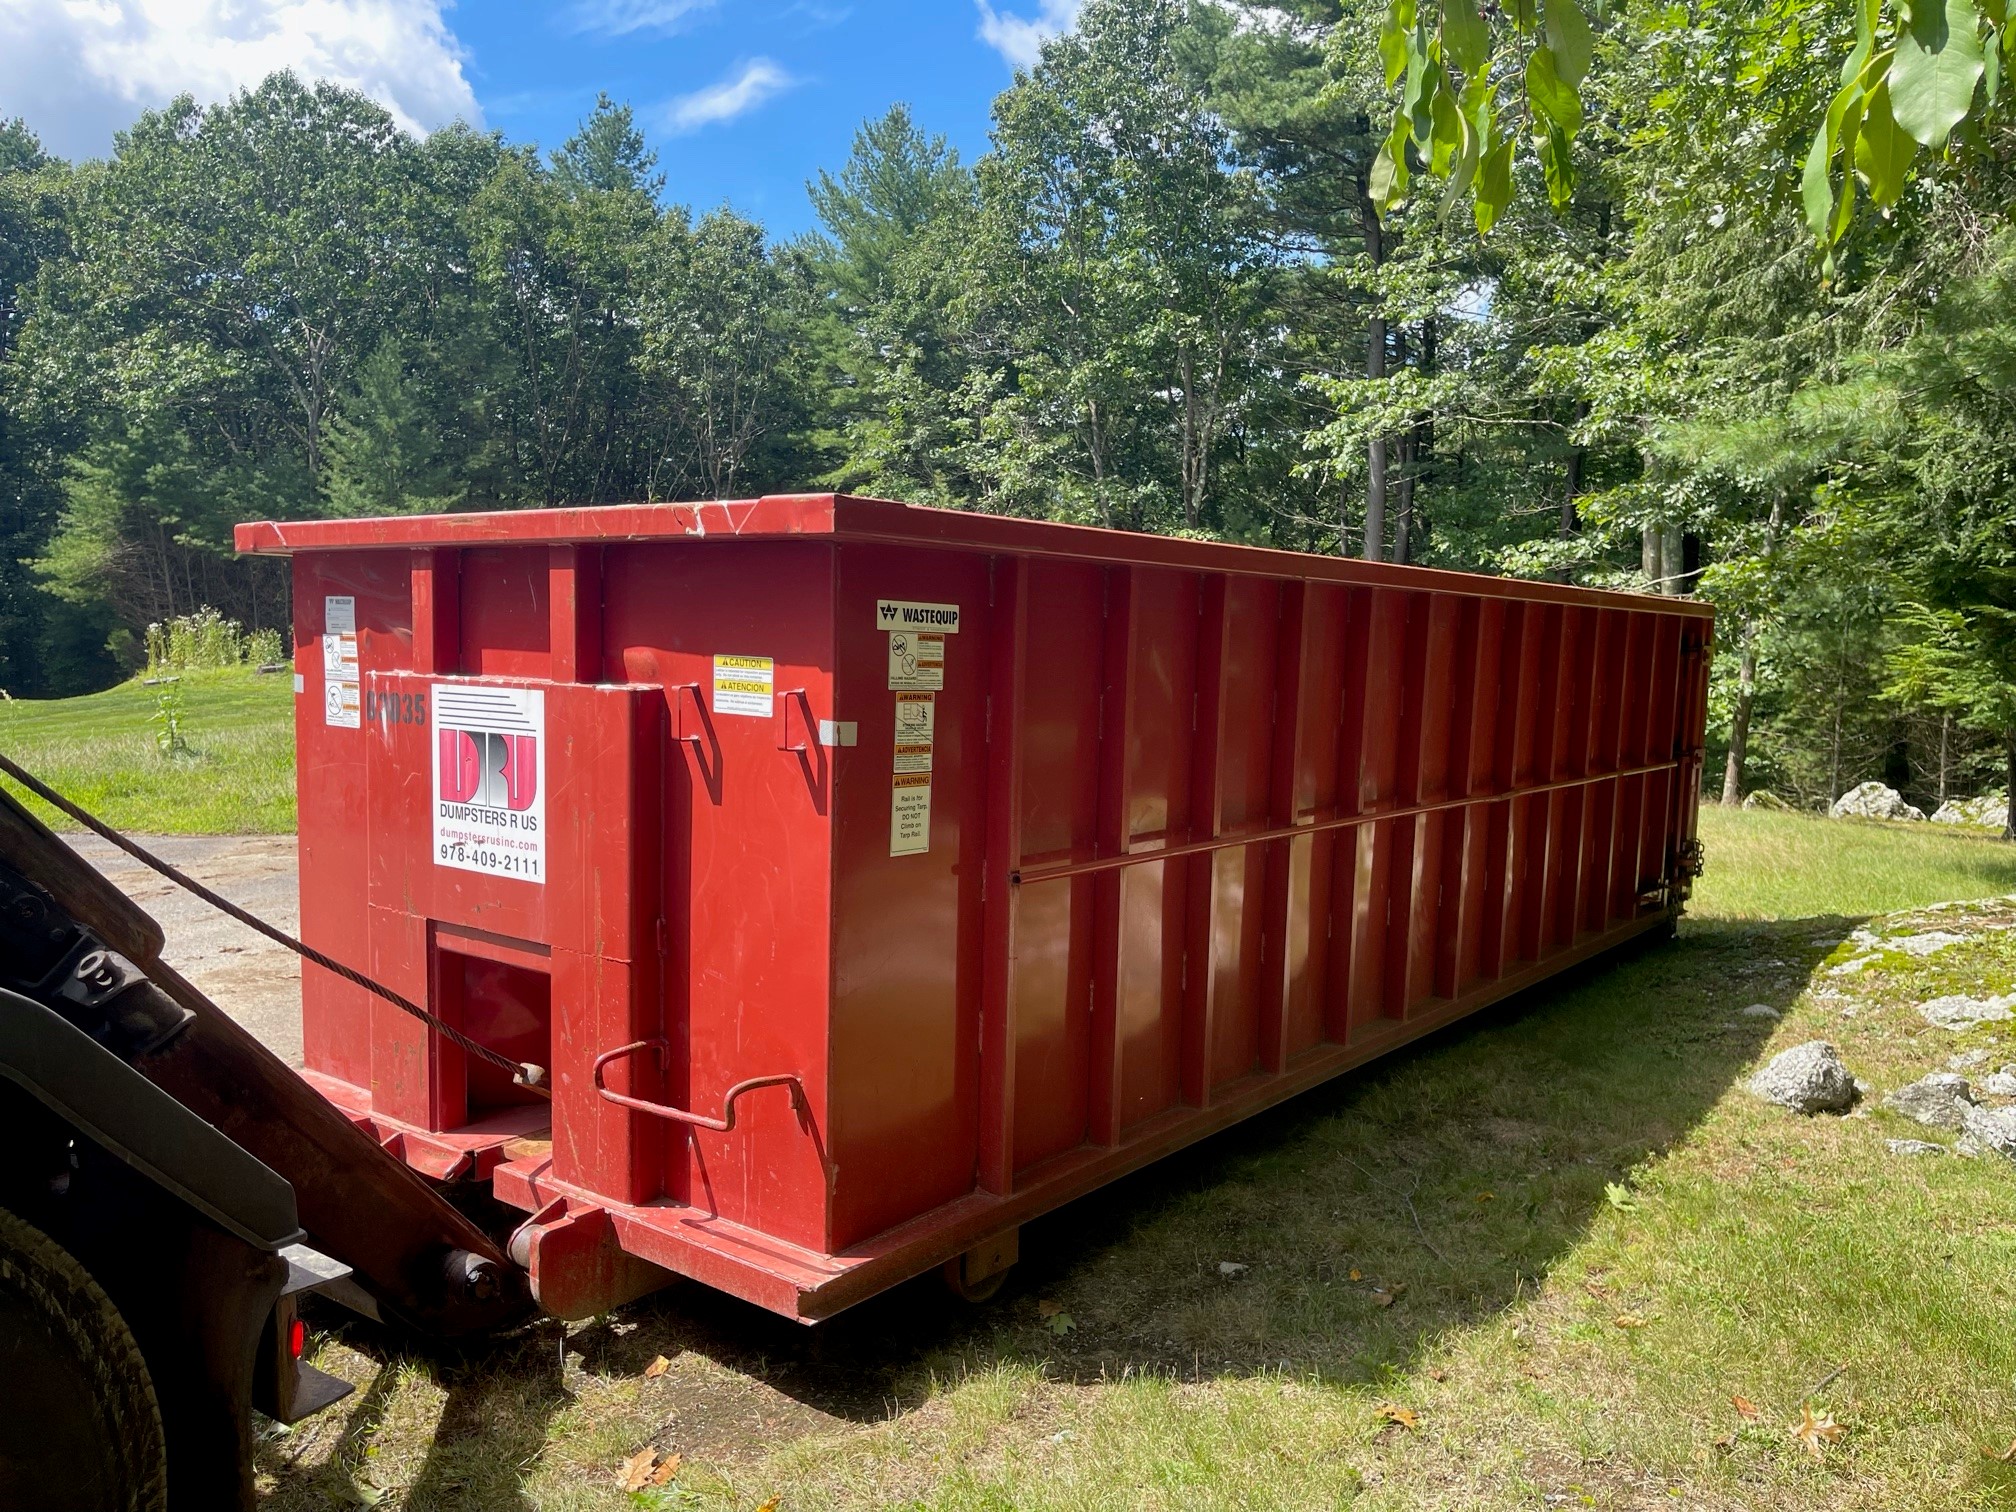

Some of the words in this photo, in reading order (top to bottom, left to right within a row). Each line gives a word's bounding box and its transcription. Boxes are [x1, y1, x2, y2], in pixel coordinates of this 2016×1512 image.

[902, 607, 958, 625] WASTEQUIP
[729, 658, 762, 668] CAUTION
[727, 681, 765, 692] ATENCION
[903, 693, 932, 701] WARNING
[902, 745, 931, 753] ADVERTENCIA
[901, 776, 930, 786] WARNING
[895, 804, 916, 812] Securing
[440, 803, 507, 828] DUMPSTERS
[510, 814, 518, 829] R
[521, 815, 538, 832] US
[901, 822, 914, 830] Climb
[440, 826, 538, 852] dumpstersrusinc.com
[440, 843, 539, 876] 978-409-2111
